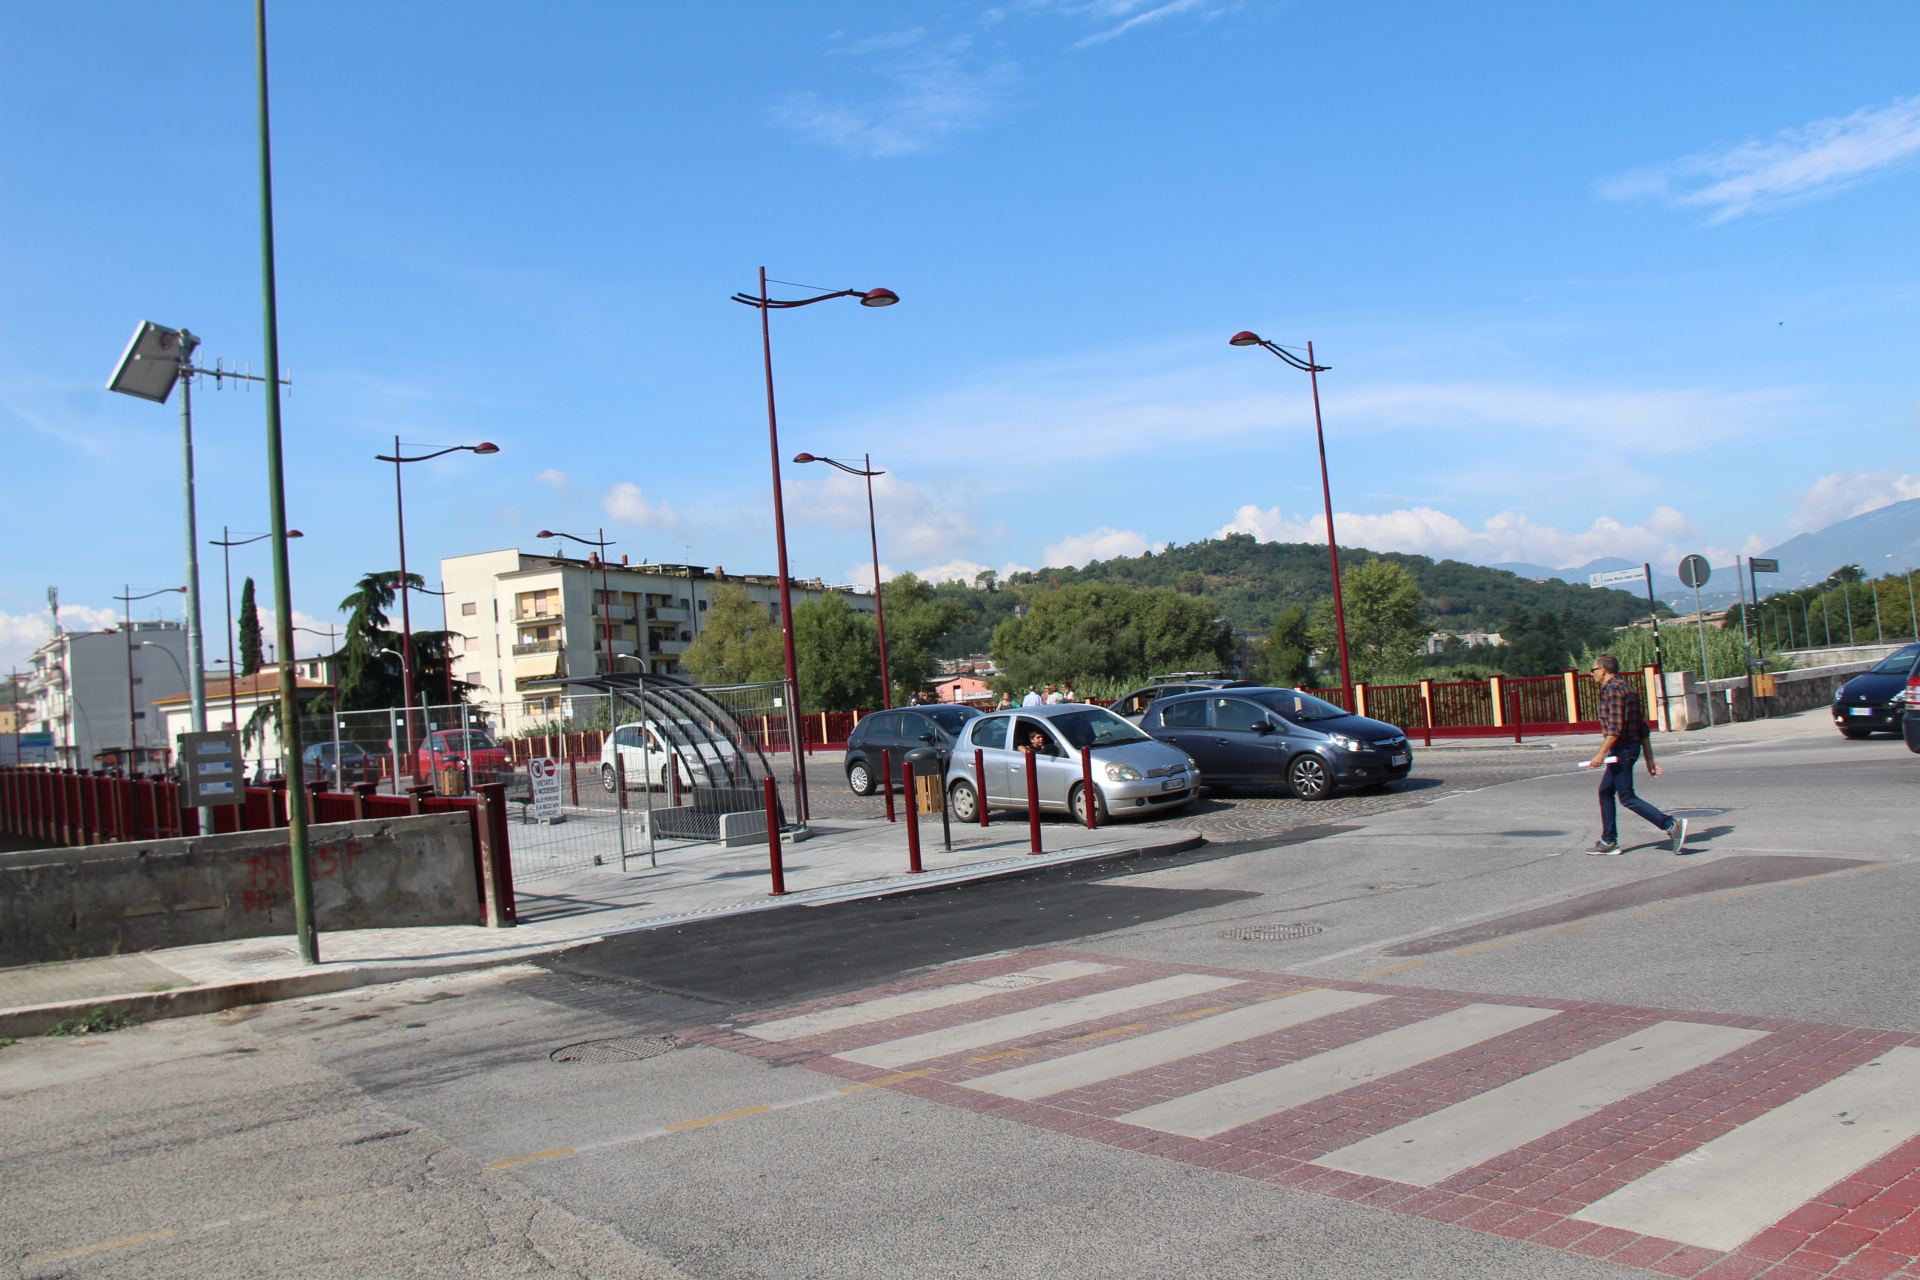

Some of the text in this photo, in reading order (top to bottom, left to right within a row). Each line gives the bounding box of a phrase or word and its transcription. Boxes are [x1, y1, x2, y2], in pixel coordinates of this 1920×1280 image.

[536, 778, 554, 787] VIETATO
[534, 786, 559, 796] L'ACCESSO
[543, 794, 559, 802] PERSONE
